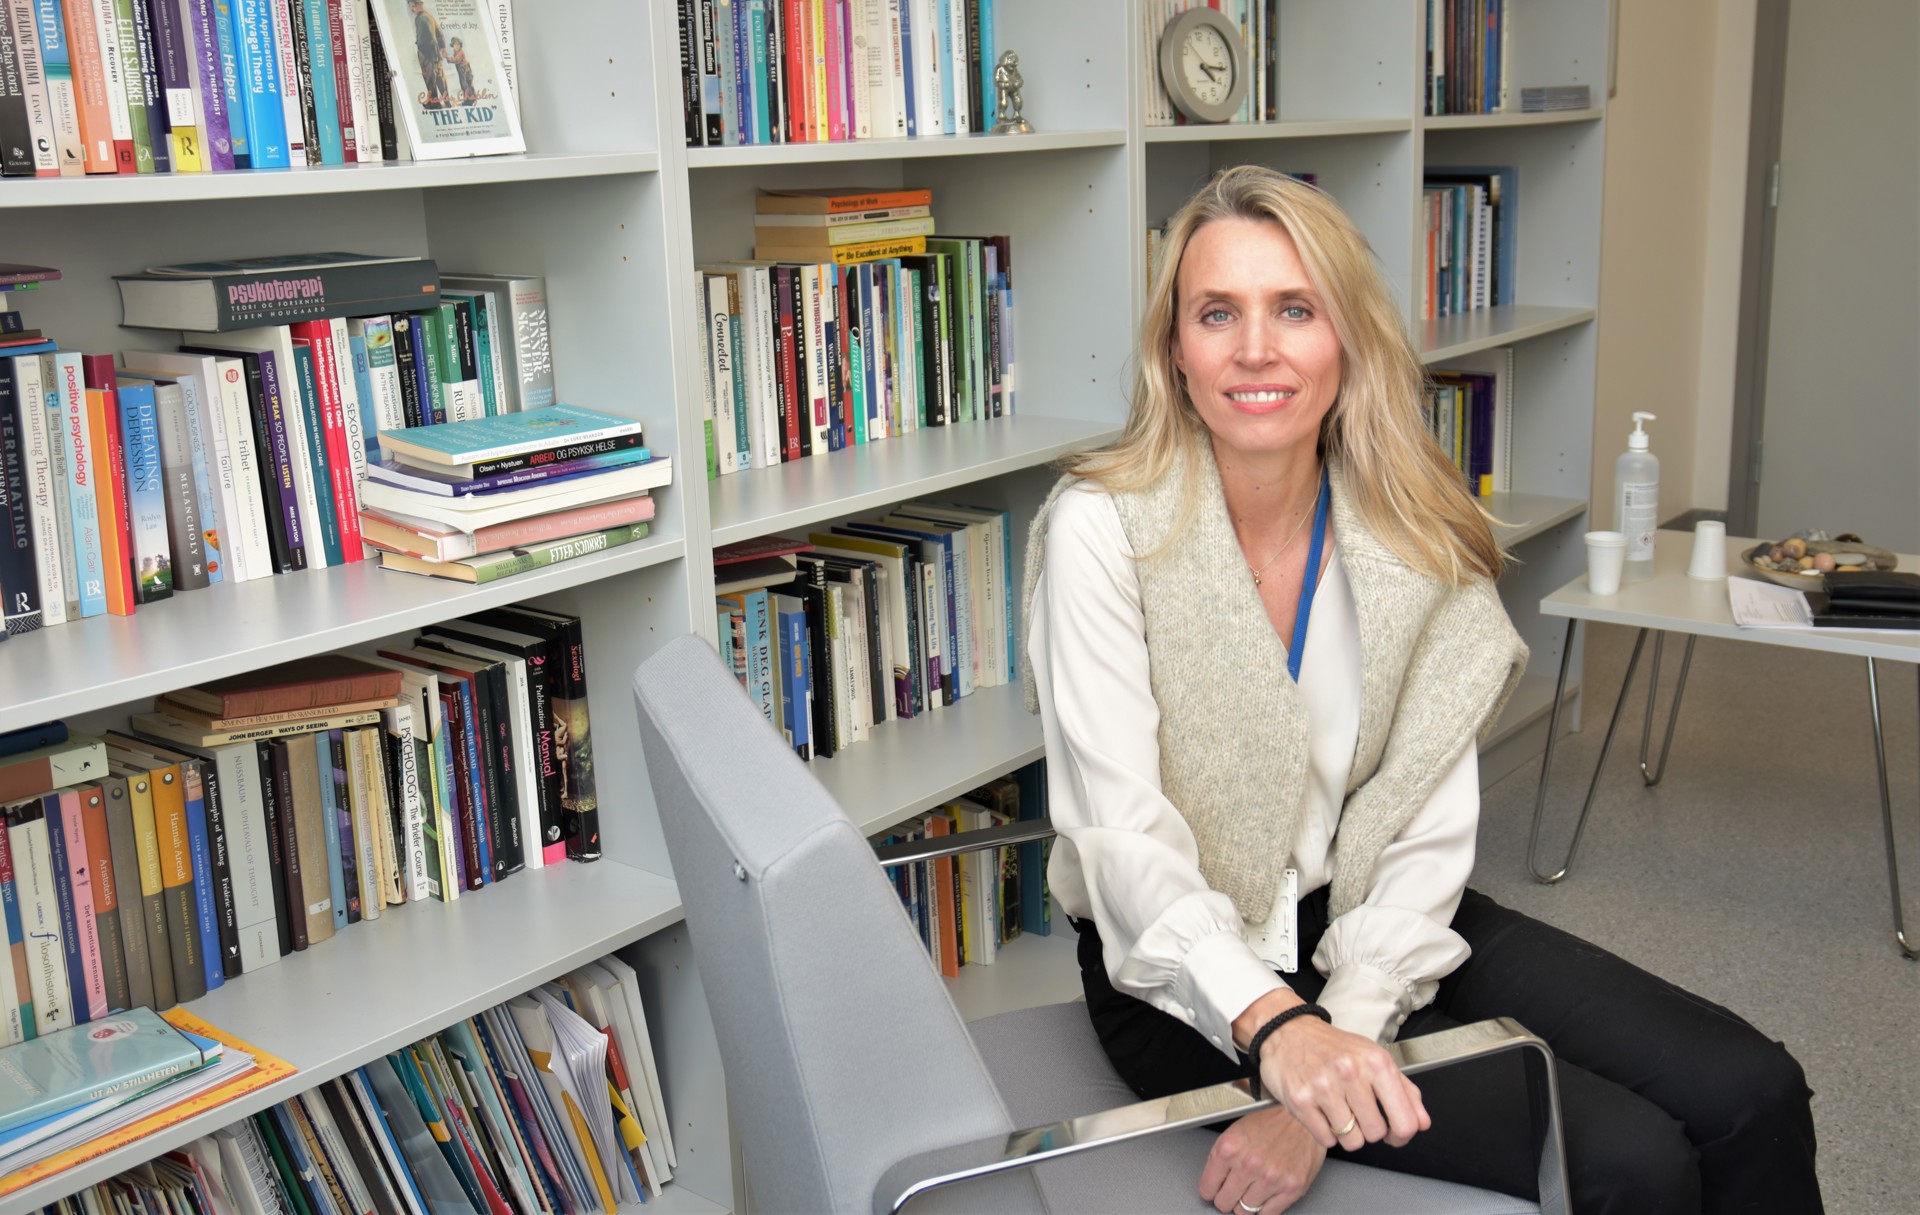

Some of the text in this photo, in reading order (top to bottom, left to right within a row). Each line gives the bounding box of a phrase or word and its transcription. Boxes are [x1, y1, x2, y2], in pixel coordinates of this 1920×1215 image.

[117, 19, 137, 53] ETTER
[311, 1, 327, 68] Traumatic Stress
[329, 3, 342, 56] PRACTITIONER
[498, 4, 509, 44] tilbake
[703, 1, 714, 71] Expressing Emotion
[732, 2, 740, 41] MESSAGE
[754, 15, 763, 63] FØLELSER
[15, 7, 44, 126] HEALING TRAUMA LEVINE
[107, 47, 118, 84] RECOVERY
[167, 50, 177, 82] Reactions
[202, 19, 220, 116] THRIVE THERAPIST
[246, 0, 264, 94] Polyvagal Theory
[259, 18, 274, 80] Applications
[300, 40, 309, 63] Guide
[687, 16, 700, 102] Consequences Feelings
[138, 43, 155, 106] Nursing Practice
[223, 53, 237, 103] Helper
[285, 52, 297, 97] HUSKER
[304, 74, 314, 108] Self-Care
[352, 66, 363, 102] Office
[361, 36, 377, 117] What Doctors Feel
[856, 245, 912, 259] Excellent Anything
[228, 276, 324, 306] psykoterapi
[231, 306, 326, 321] ESBEN HOUGAARD
[232, 297, 325, 313] TEORI FORSKNING
[914, 286, 922, 312] change
[537, 309, 552, 374] NORSKE
[714, 313, 730, 373] Connected
[795, 277, 804, 359] COMPLEXITIES
[812, 293, 825, 387] ENTHUSIASTIC EMPLOYEE
[302, 357, 312, 389] KNOWLEDGE
[517, 311, 534, 385] SKALLER
[734, 338, 743, 382] Management
[850, 327, 862, 393] Ostracism
[64, 366, 80, 413] positive
[388, 372, 400, 420] Motivational
[427, 354, 440, 409] RETHINKING
[777, 383, 785, 417] PASIENTEN
[827, 343, 837, 407] WORKSTRESS
[50, 414, 59, 431] Doing
[186, 389, 202, 453] GOOD BUSINESS
[265, 362, 292, 489] HOW SPEAK PEOPLE LISTEN
[326, 411, 334, 429] Oslo
[335, 410, 343, 428] Oslo
[347, 403, 361, 462] SEXOLOGI
[382, 393, 392, 426] TREATMENT
[27, 380, 50, 508] Terminating Therapy
[52, 433, 63, 456] Therapy
[54, 457, 67, 477] Briefly
[70, 416, 87, 488] psychology
[127, 406, 148, 493] DEPRESSION
[139, 405, 159, 491] DEFEATING
[238, 440, 252, 472] Frihet
[479, 459, 523, 472] Olsen Nystuen
[530, 453, 555, 465] ARBEID
[568, 445, 595, 459] PSYKISK
[596, 440, 616, 453] HELSE
[2, 414, 28, 550] TERMINATING
[220, 456, 231, 489] failure
[84, 527, 94, 550] Alan
[180, 473, 198, 556] MELANCHOLY
[87, 552, 97, 574] Carr
[550, 535, 608, 563] ETTER SJOKKET
[953, 553, 966, 669] Personlighedsforstyrrelser
[570, 645, 581, 682] Sexologi
[757, 598, 772, 724] TENK DEG GLAD
[228, 721, 329, 741] JOHN BERGER WAYS SEEING
[463, 695, 473, 730] SHARING
[535, 684, 556, 776] Publication Manual
[209, 781, 226, 867] Philosophy Walking
[265, 777, 281, 864] Arne Næss Livsfilosofi
[401, 727, 425, 878] PSYCHOLOGY: The Briefer Course
[474, 783, 486, 843] Gwendoline Smith
[170, 812, 186, 880] Hannah Arendt
[234, 755, 259, 907] NUSSBAUM UPHEAVALS THOUGHT
[99, 859, 112, 906] Aristoteles
[145, 832, 160, 889] Martin Buber
[365, 847, 376, 886] GARY COX
[2, 871, 13, 902] fotspor
[222, 877, 232, 908] Frédéric
[60, 876, 76, 954] SENSIBILITET REFLEKSJON
[180, 890, 194, 966] EICHMANN JERUSALEM
[30, 932, 58, 1009] filosofihistorie
[84, 904, 101, 995] Det autentiske menneske
[122, 1064, 181, 1090] STILLHETEN
